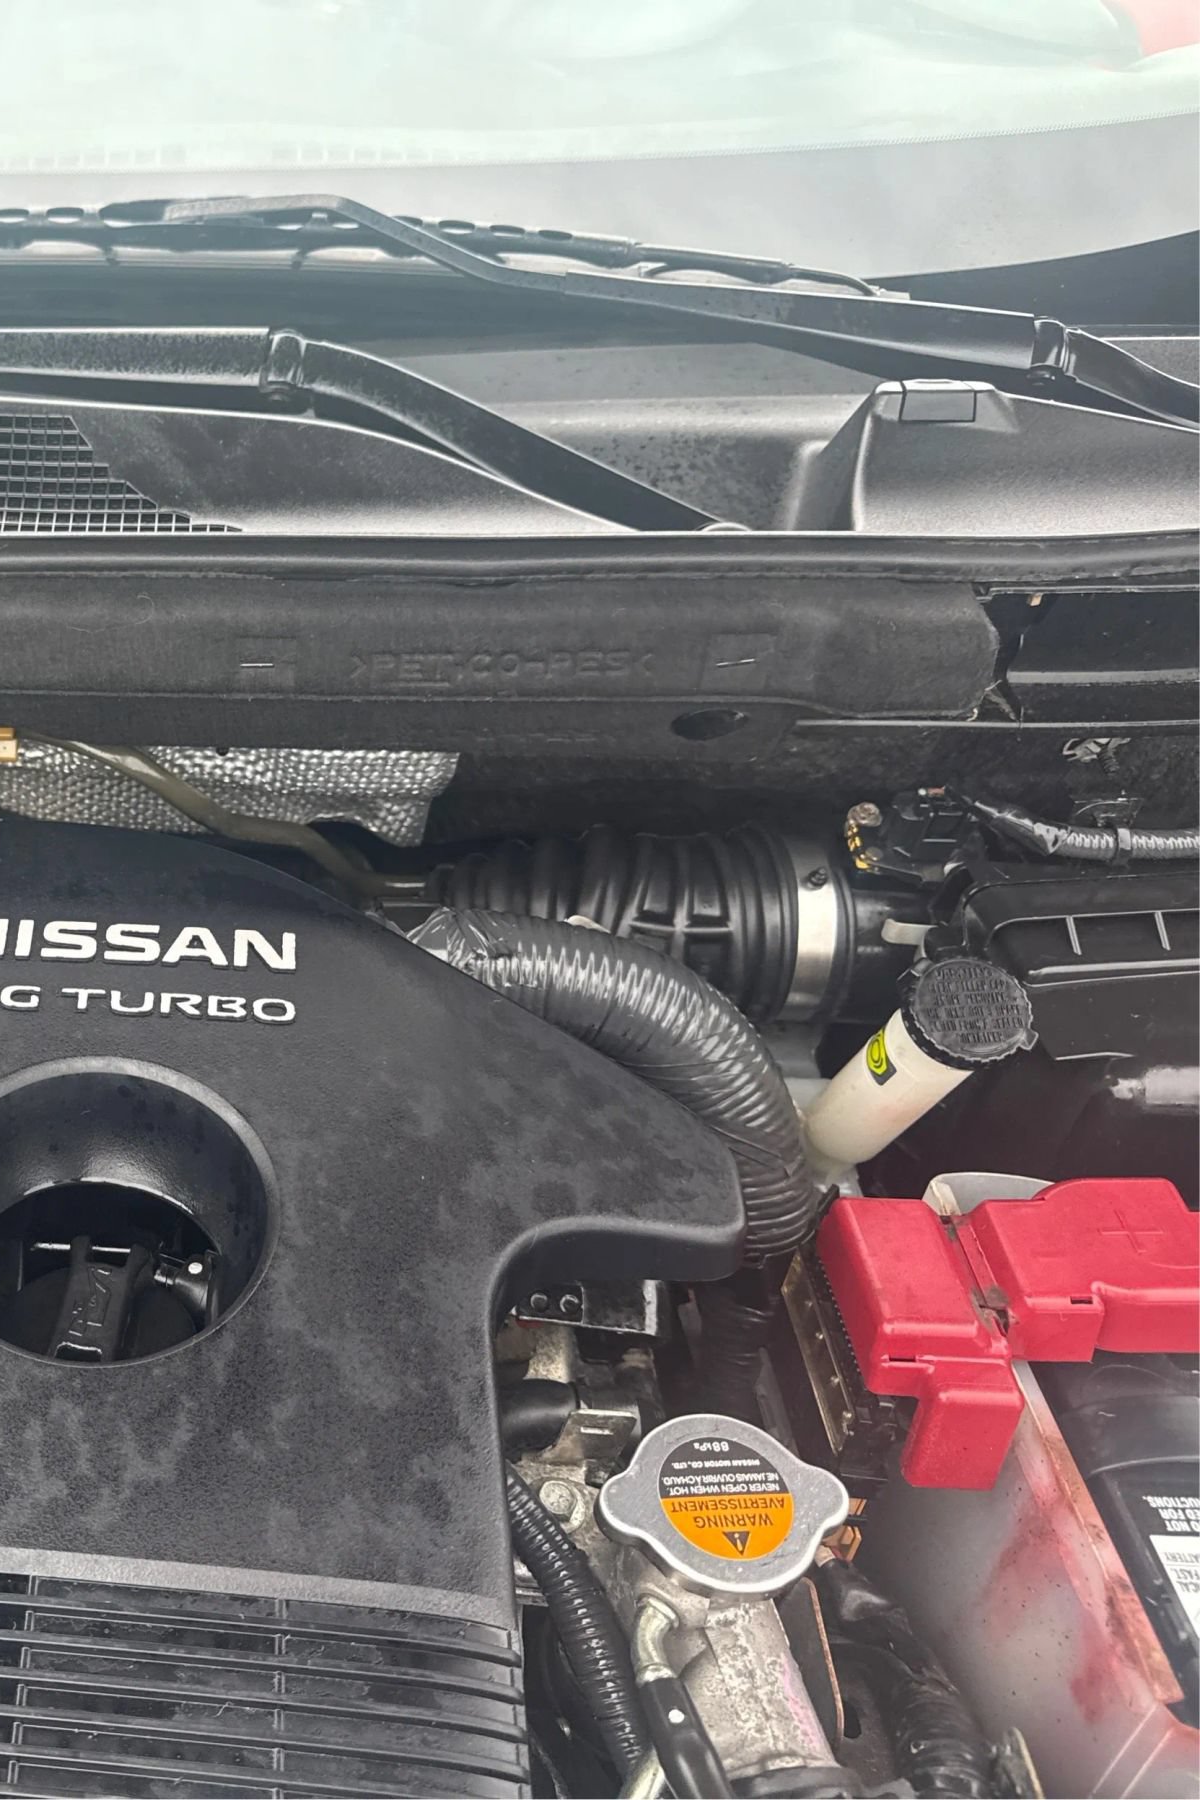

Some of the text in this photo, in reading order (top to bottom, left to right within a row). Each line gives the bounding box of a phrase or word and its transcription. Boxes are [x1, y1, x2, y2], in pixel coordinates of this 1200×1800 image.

[61, 987, 296, 1025] TURBO
[661, 1475, 695, 1485] CHAUD.
[702, 1473, 736, 1483] OUVRIR
[736, 1473, 768, 1481] JAMAIS
[768, 1472, 779, 1480] NE
[666, 1483, 780, 1496] NEVER OPEN WHEN HOT.
[671, 1497, 785, 1513] AVERTISSEMENT
[692, 1513, 774, 1529] WARNING
